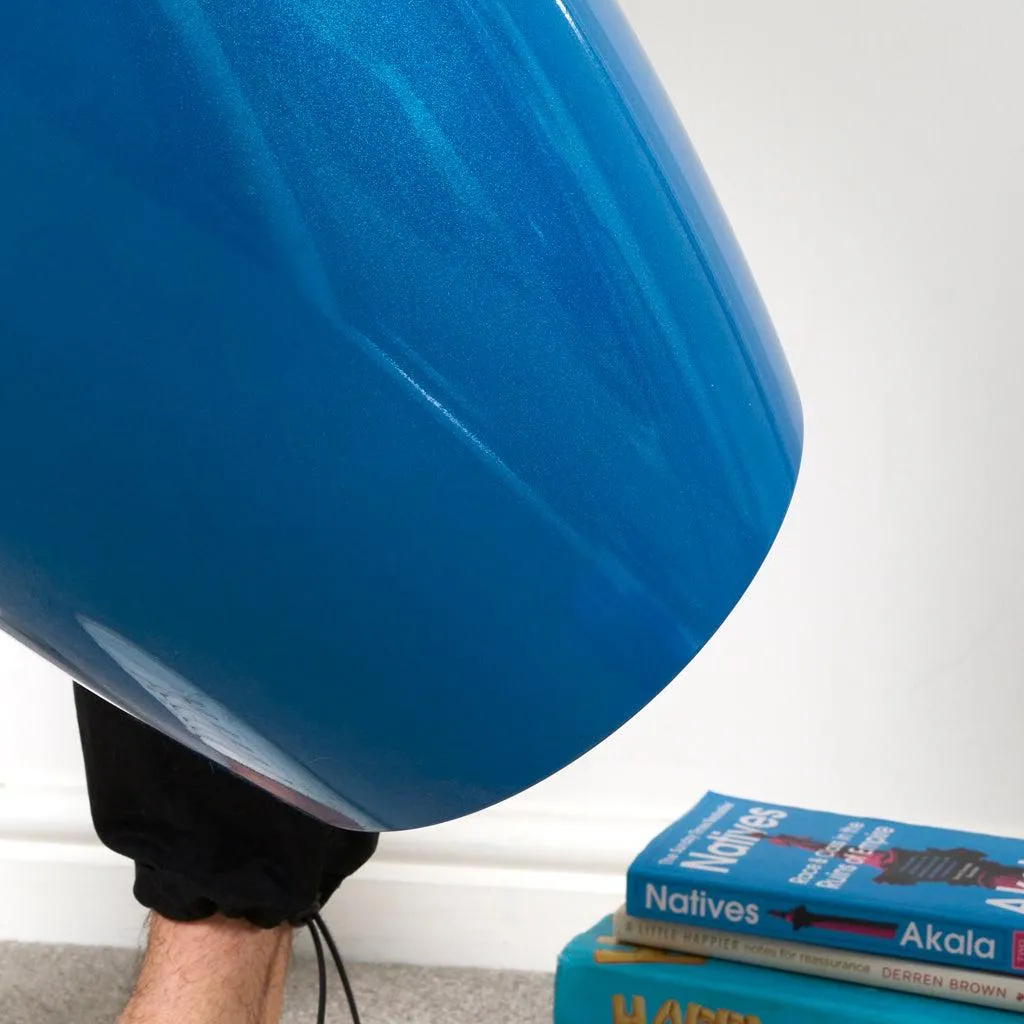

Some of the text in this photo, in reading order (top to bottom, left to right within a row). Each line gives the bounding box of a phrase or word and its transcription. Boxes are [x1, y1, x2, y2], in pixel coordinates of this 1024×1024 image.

[680, 807, 788, 873] Natives
[645, 883, 996, 960] Natives Akala
[683, 931, 740, 952] HAPPIER
[780, 948, 797, 961] for
[799, 952, 872, 974] reassurance
[881, 966, 944, 988] DERREN
[949, 978, 1008, 999] BROWN
